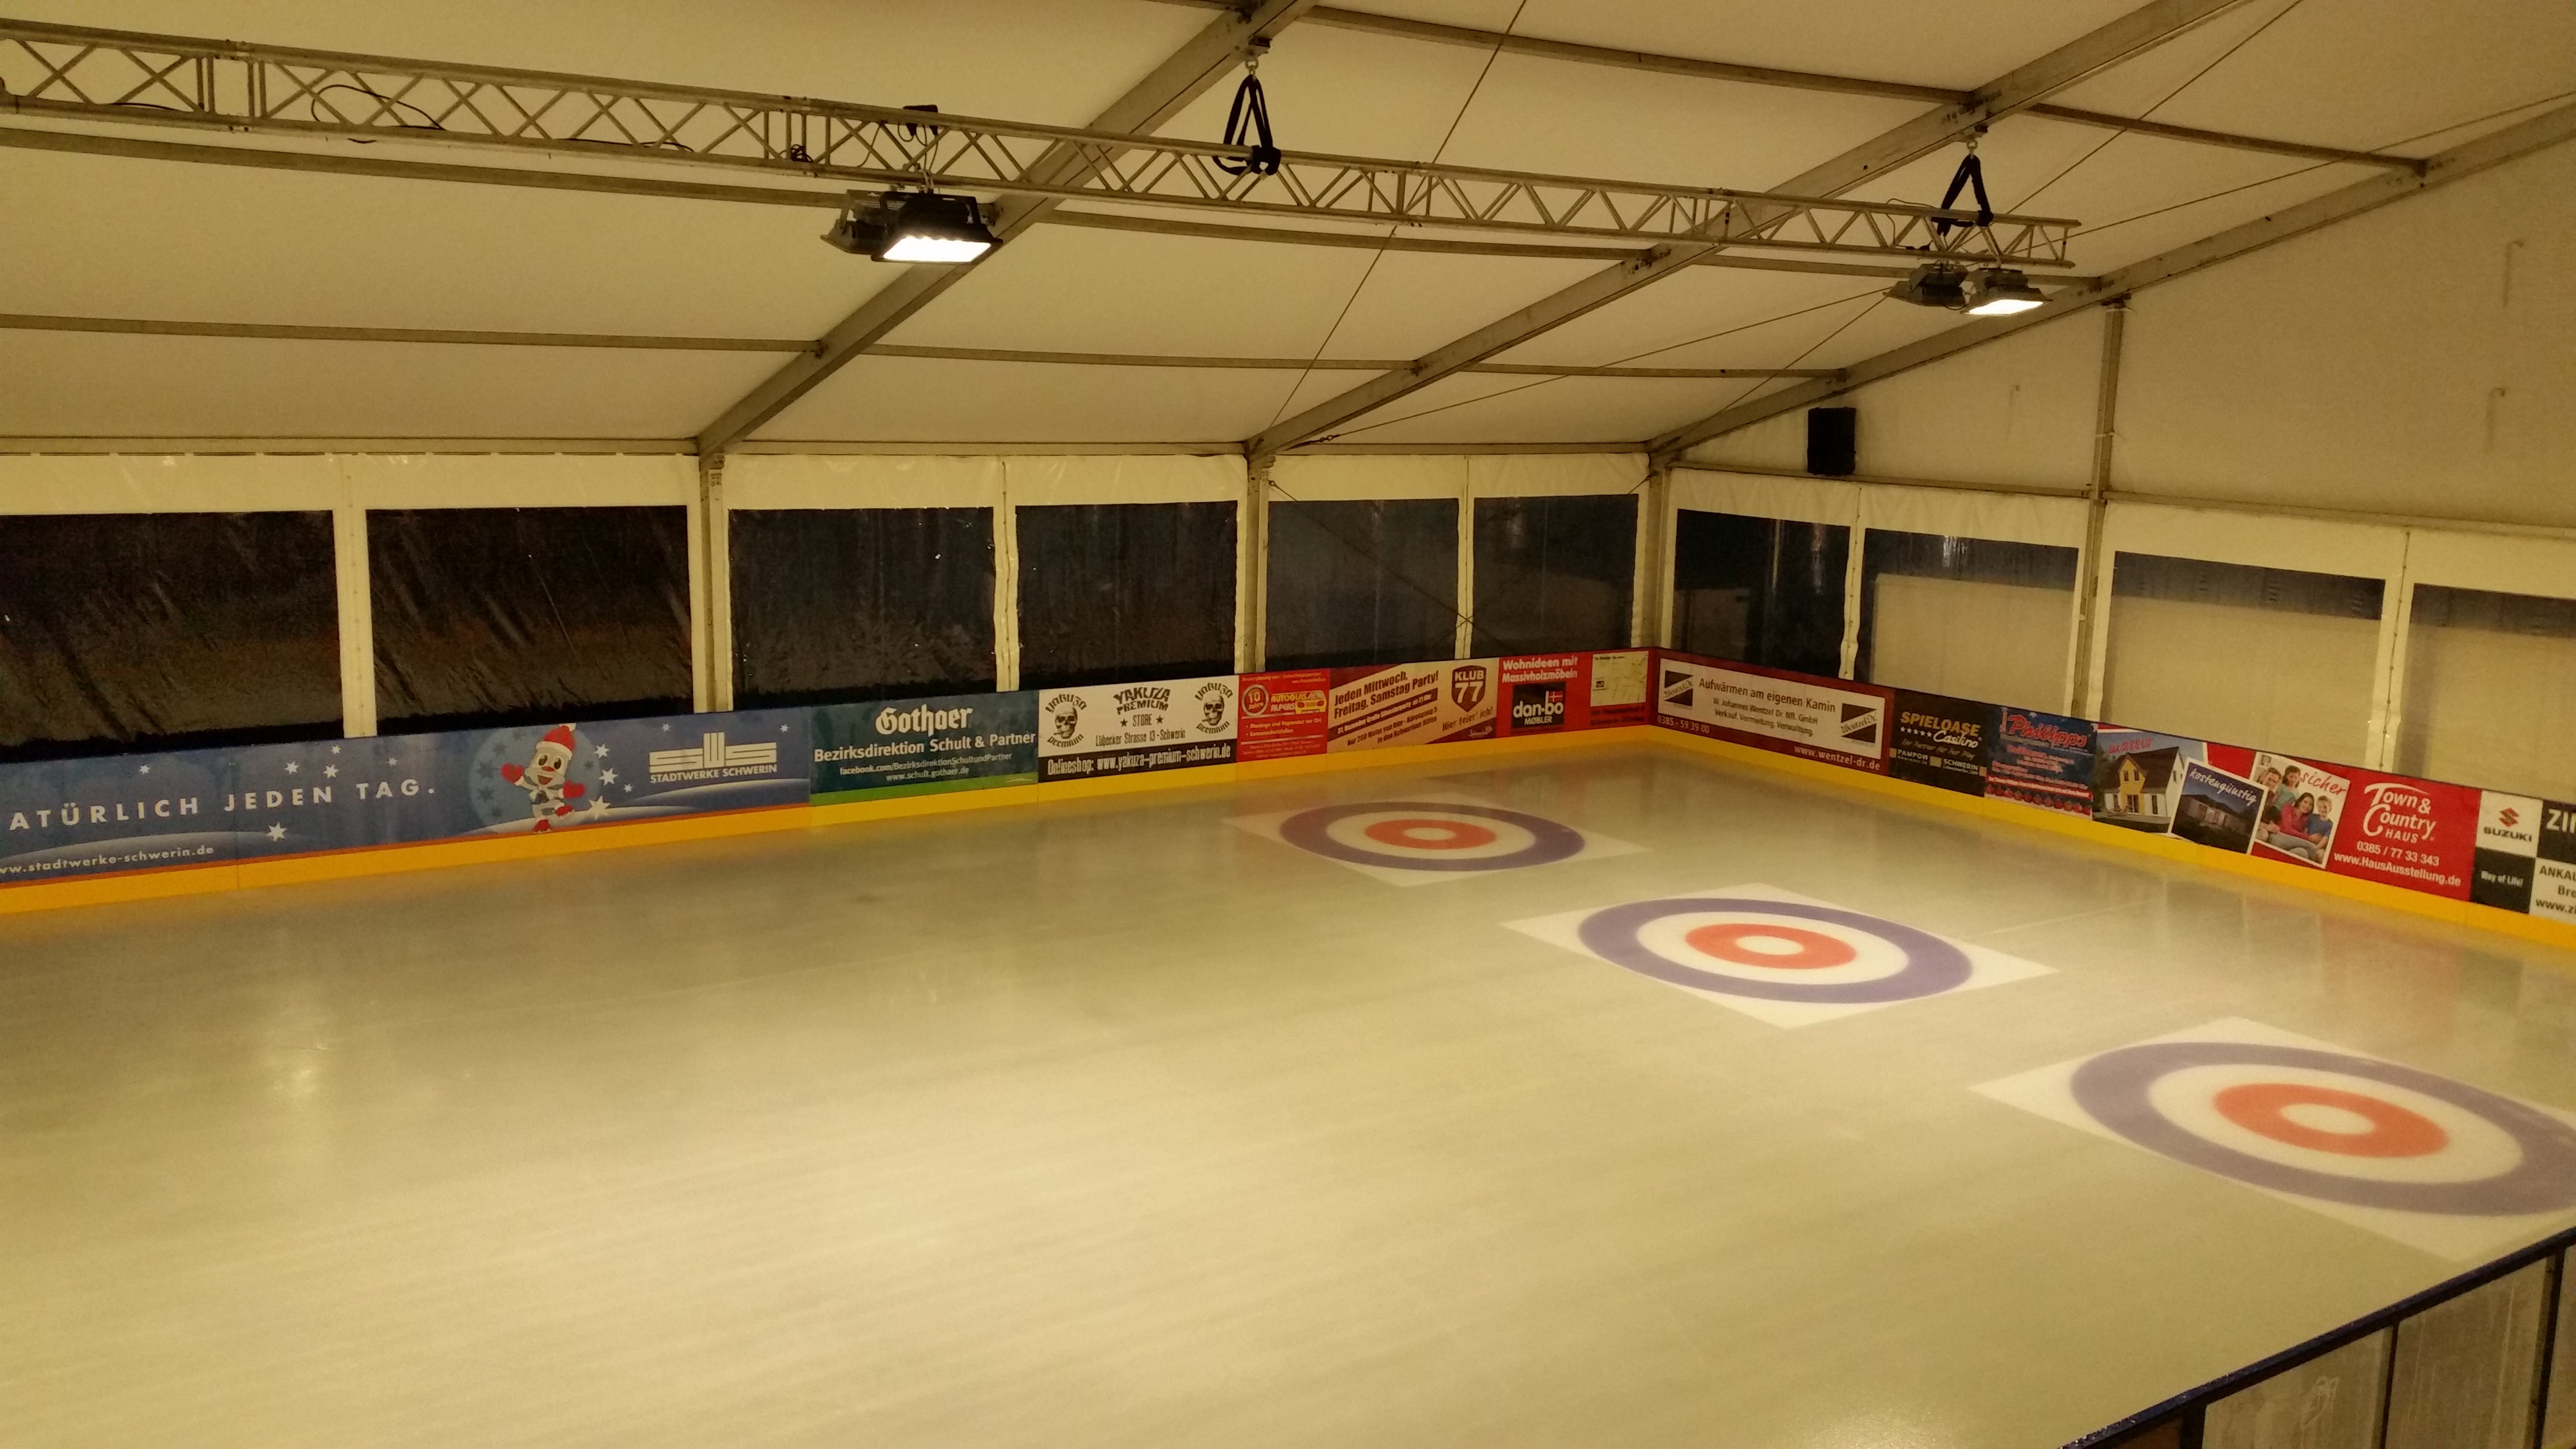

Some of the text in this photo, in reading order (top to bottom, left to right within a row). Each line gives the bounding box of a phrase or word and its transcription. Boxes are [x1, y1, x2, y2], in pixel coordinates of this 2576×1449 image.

[1503, 655, 1578, 671] Wohnideen mit
[1455, 670, 1484, 681] KLUB
[1502, 667, 1578, 683] Massivholzmöbeln
[1113, 687, 1171, 705] YAKUZA
[1248, 692, 1260, 703] 10
[1334, 688, 1362, 706] Jeden
[1370, 683, 1410, 705] Samstag
[1412, 670, 1439, 690] Party!
[1455, 681, 1483, 703] 77
[1699, 678, 1836, 713] Aufwärmen am eigenen Kamin
[1116, 700, 1169, 715] PREMIUM
[1722, 699, 1748, 710] Johannes
[1750, 705, 1773, 715] Wentzel
[1798, 714, 1818, 724] GmbH
[875, 703, 973, 737] Gothaer
[1132, 714, 1152, 727] STORE
[1442, 720, 1457, 731] Hier
[1658, 715, 1674, 726] 0385
[1680, 720, 1689, 729] 59
[1690, 722, 1699, 731] 39
[1701, 724, 1710, 734] 00
[1900, 711, 1981, 737] SPIELOASE
[2007, 714, 2088, 747] Philipps
[814, 732, 1036, 762] Bezirksdirektion Schult & Partner
[1095, 734, 1122, 747] Lübecker
[1124, 730, 1147, 744] Strasse
[1933, 730, 1979, 748] Casilino
[1047, 759, 1094, 775] Onlineshop:
[1097, 743, 1231, 771] www.yakuza-premium-schwerin.de
[1794, 745, 1880, 771] www.wentzel-dr.de
[1898, 749, 1928, 760] PAMPOW
[1943, 758, 1979, 771] SCHWERIN
[650, 764, 777, 784] STADTWERKE SCHWERIN
[2300, 770, 2347, 796] sicher
[224, 785, 332, 812] JEDEN
[355, 778, 435, 800] TAG.
[2189, 768, 2257, 806] kostengünstig
[2364, 782, 2431, 815] Town &
[2363, 804, 2436, 840] Country
[2385, 827, 2418, 844] HAUS
[2483, 826, 2532, 842] SUZUKI
[2356, 840, 2381, 855] 0385
[2390, 847, 2403, 859] 77
[2405, 850, 2417, 863] 33
[2420, 853, 2439, 867] 343
[2334, 852, 2461, 887] www.HausAusstellung.de
[2481, 870, 2497, 883] Way
[2497, 874, 2506, 883] of
